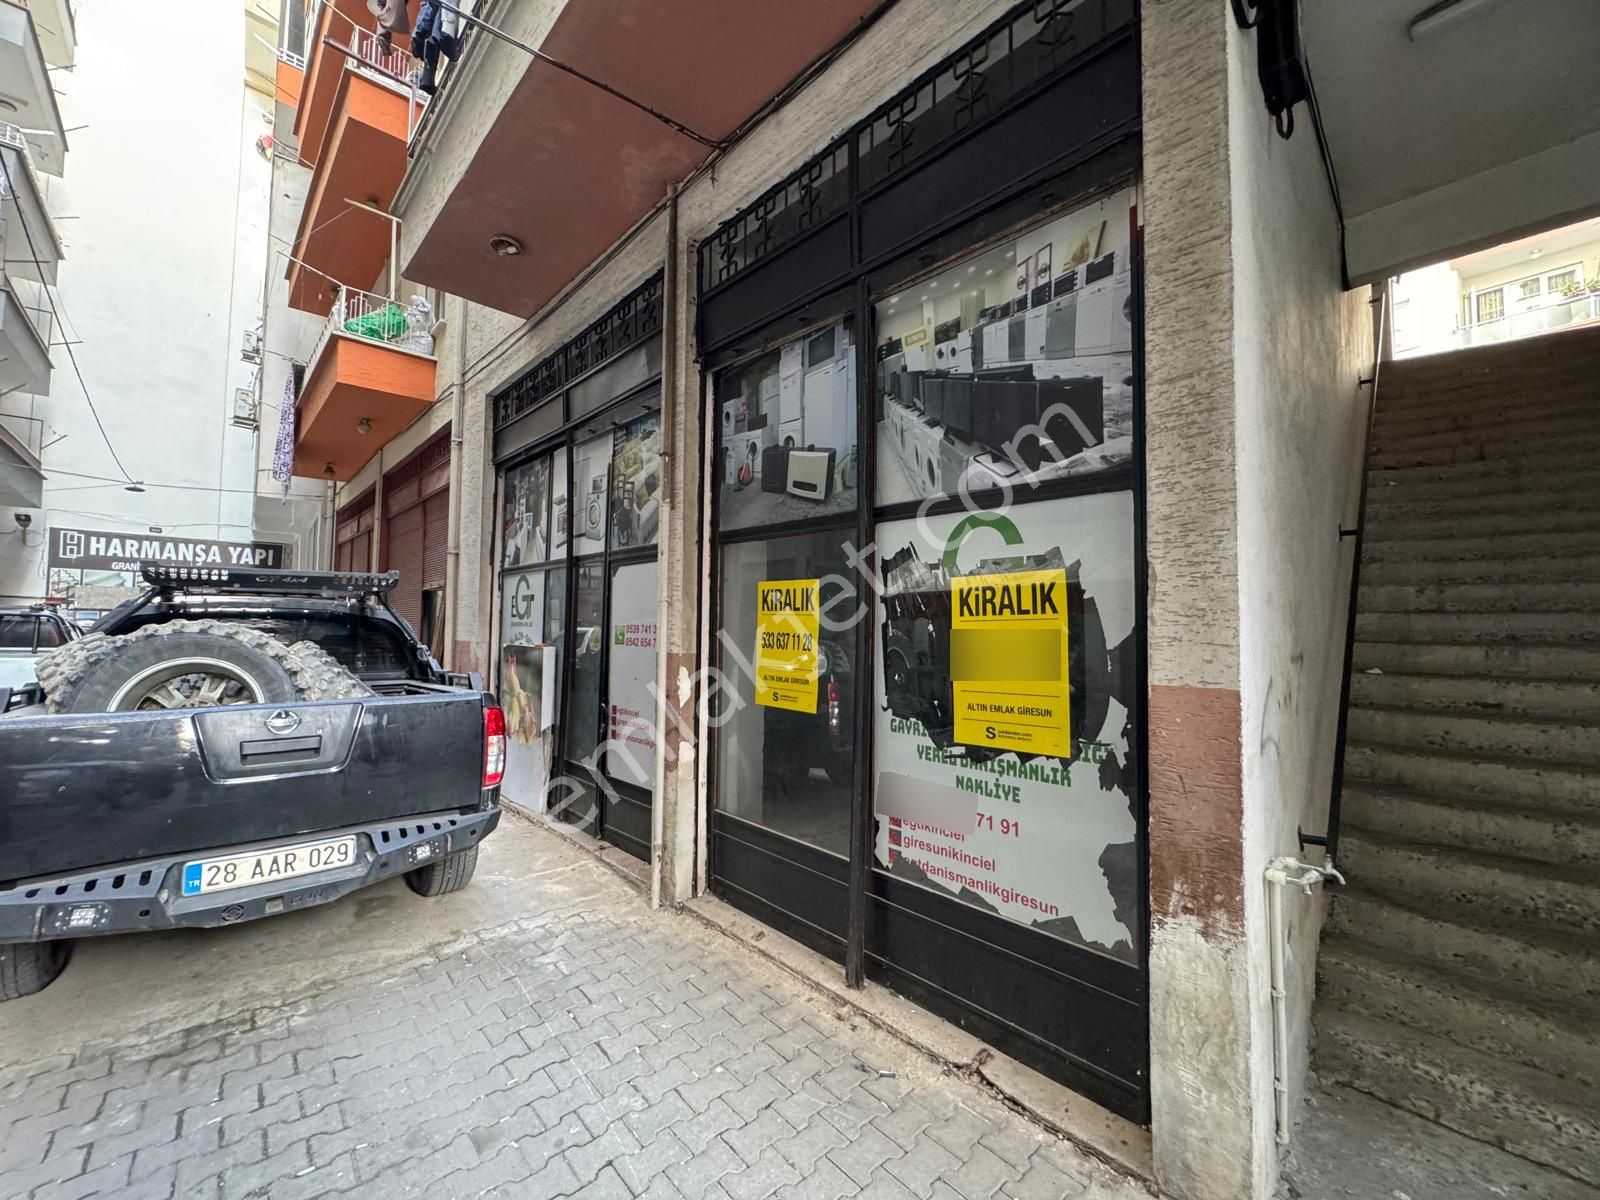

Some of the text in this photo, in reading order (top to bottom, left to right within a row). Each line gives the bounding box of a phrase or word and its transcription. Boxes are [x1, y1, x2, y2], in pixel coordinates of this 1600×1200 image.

[90, 536, 274, 566] HARMANŞA YAPI
[112, 561, 142, 571] GRANİ
[761, 631, 813, 652] 533 637 11 28
[967, 702, 1053, 718] ALTIN EMLAK GİRESUN
[985, 726, 997, 740] S
[955, 775, 1021, 803] NAKLİYE
[976, 812, 1020, 837] 71 91
[206, 842, 349, 887] 28 AAR 029
[903, 835, 996, 872] giresunikinciel
[188, 880, 200, 888] TR
